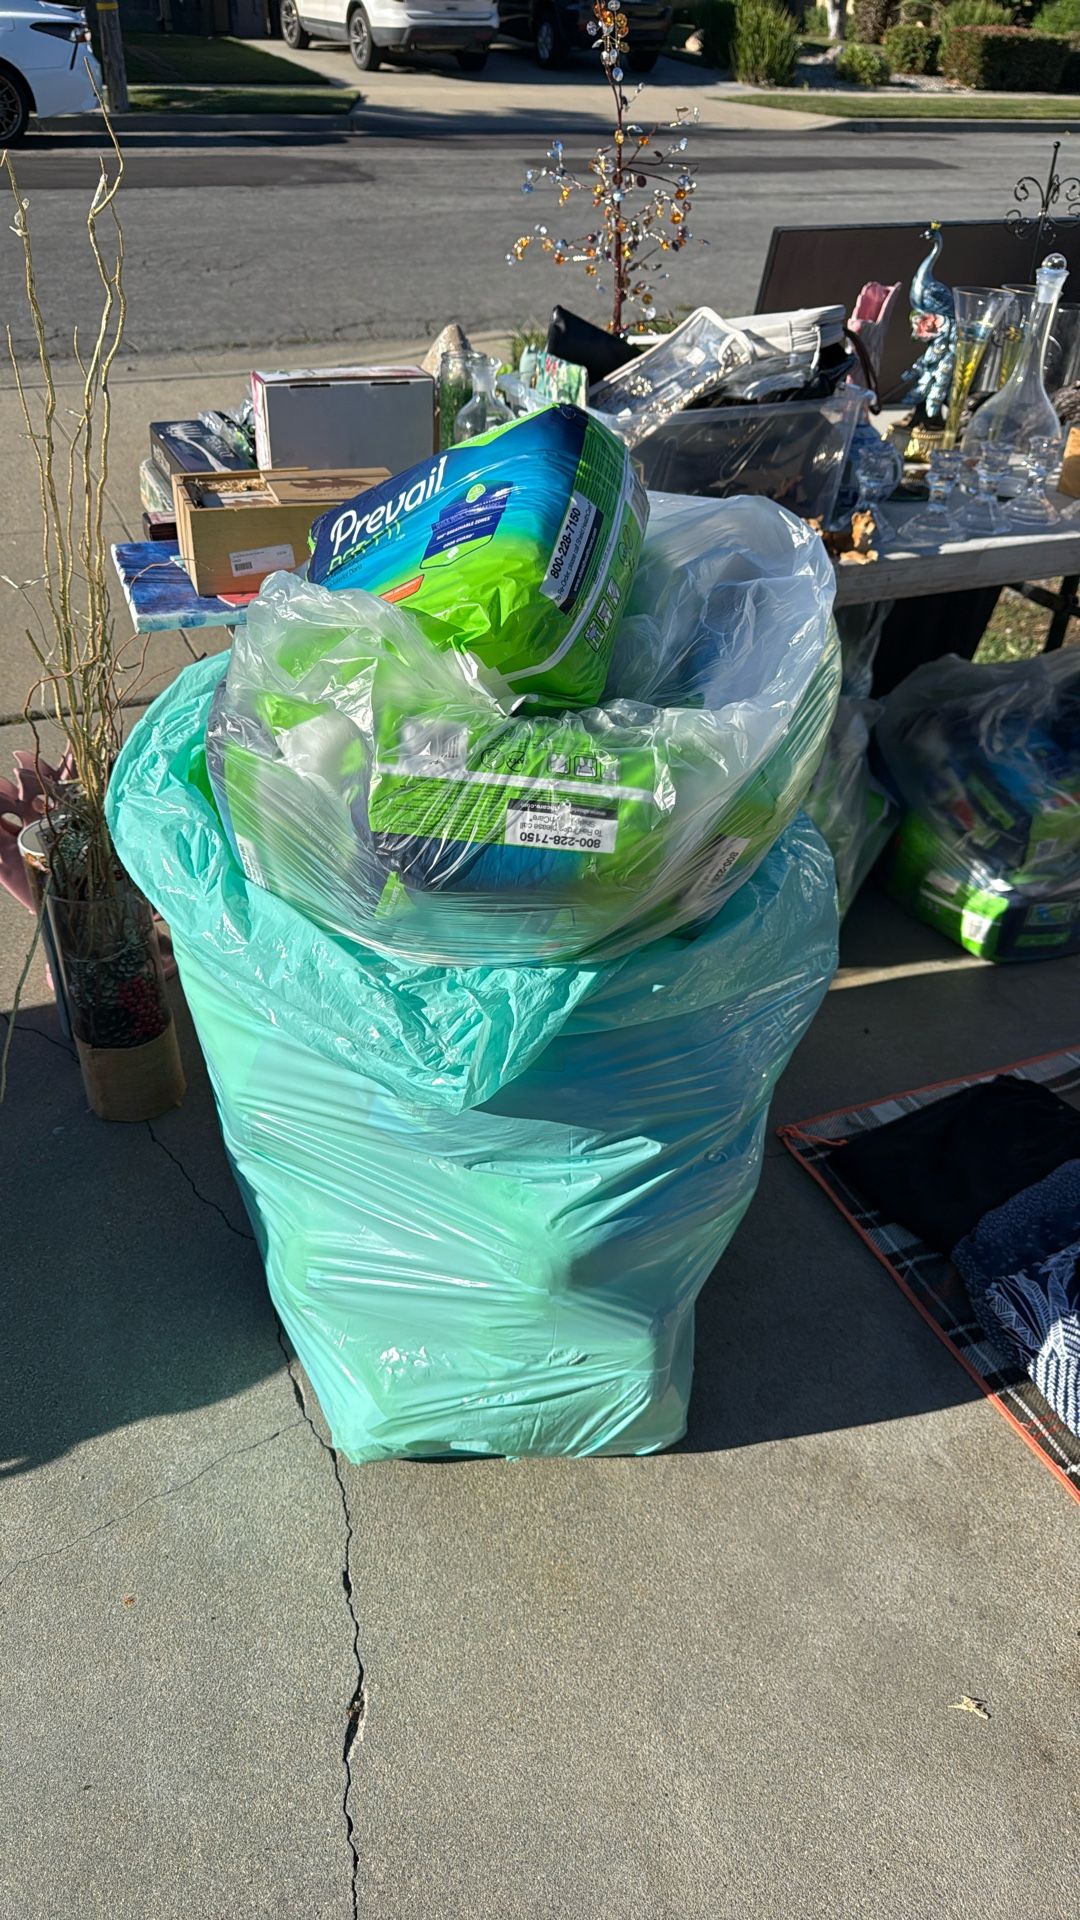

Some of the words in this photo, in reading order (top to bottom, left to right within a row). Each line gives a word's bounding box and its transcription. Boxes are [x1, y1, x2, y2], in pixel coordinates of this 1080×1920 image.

[330, 455, 448, 556] Prevail
[550, 507, 581, 580] 800-228-7150
[520, 831, 602, 849] 800-228-7150
[594, 829, 602, 838] To
